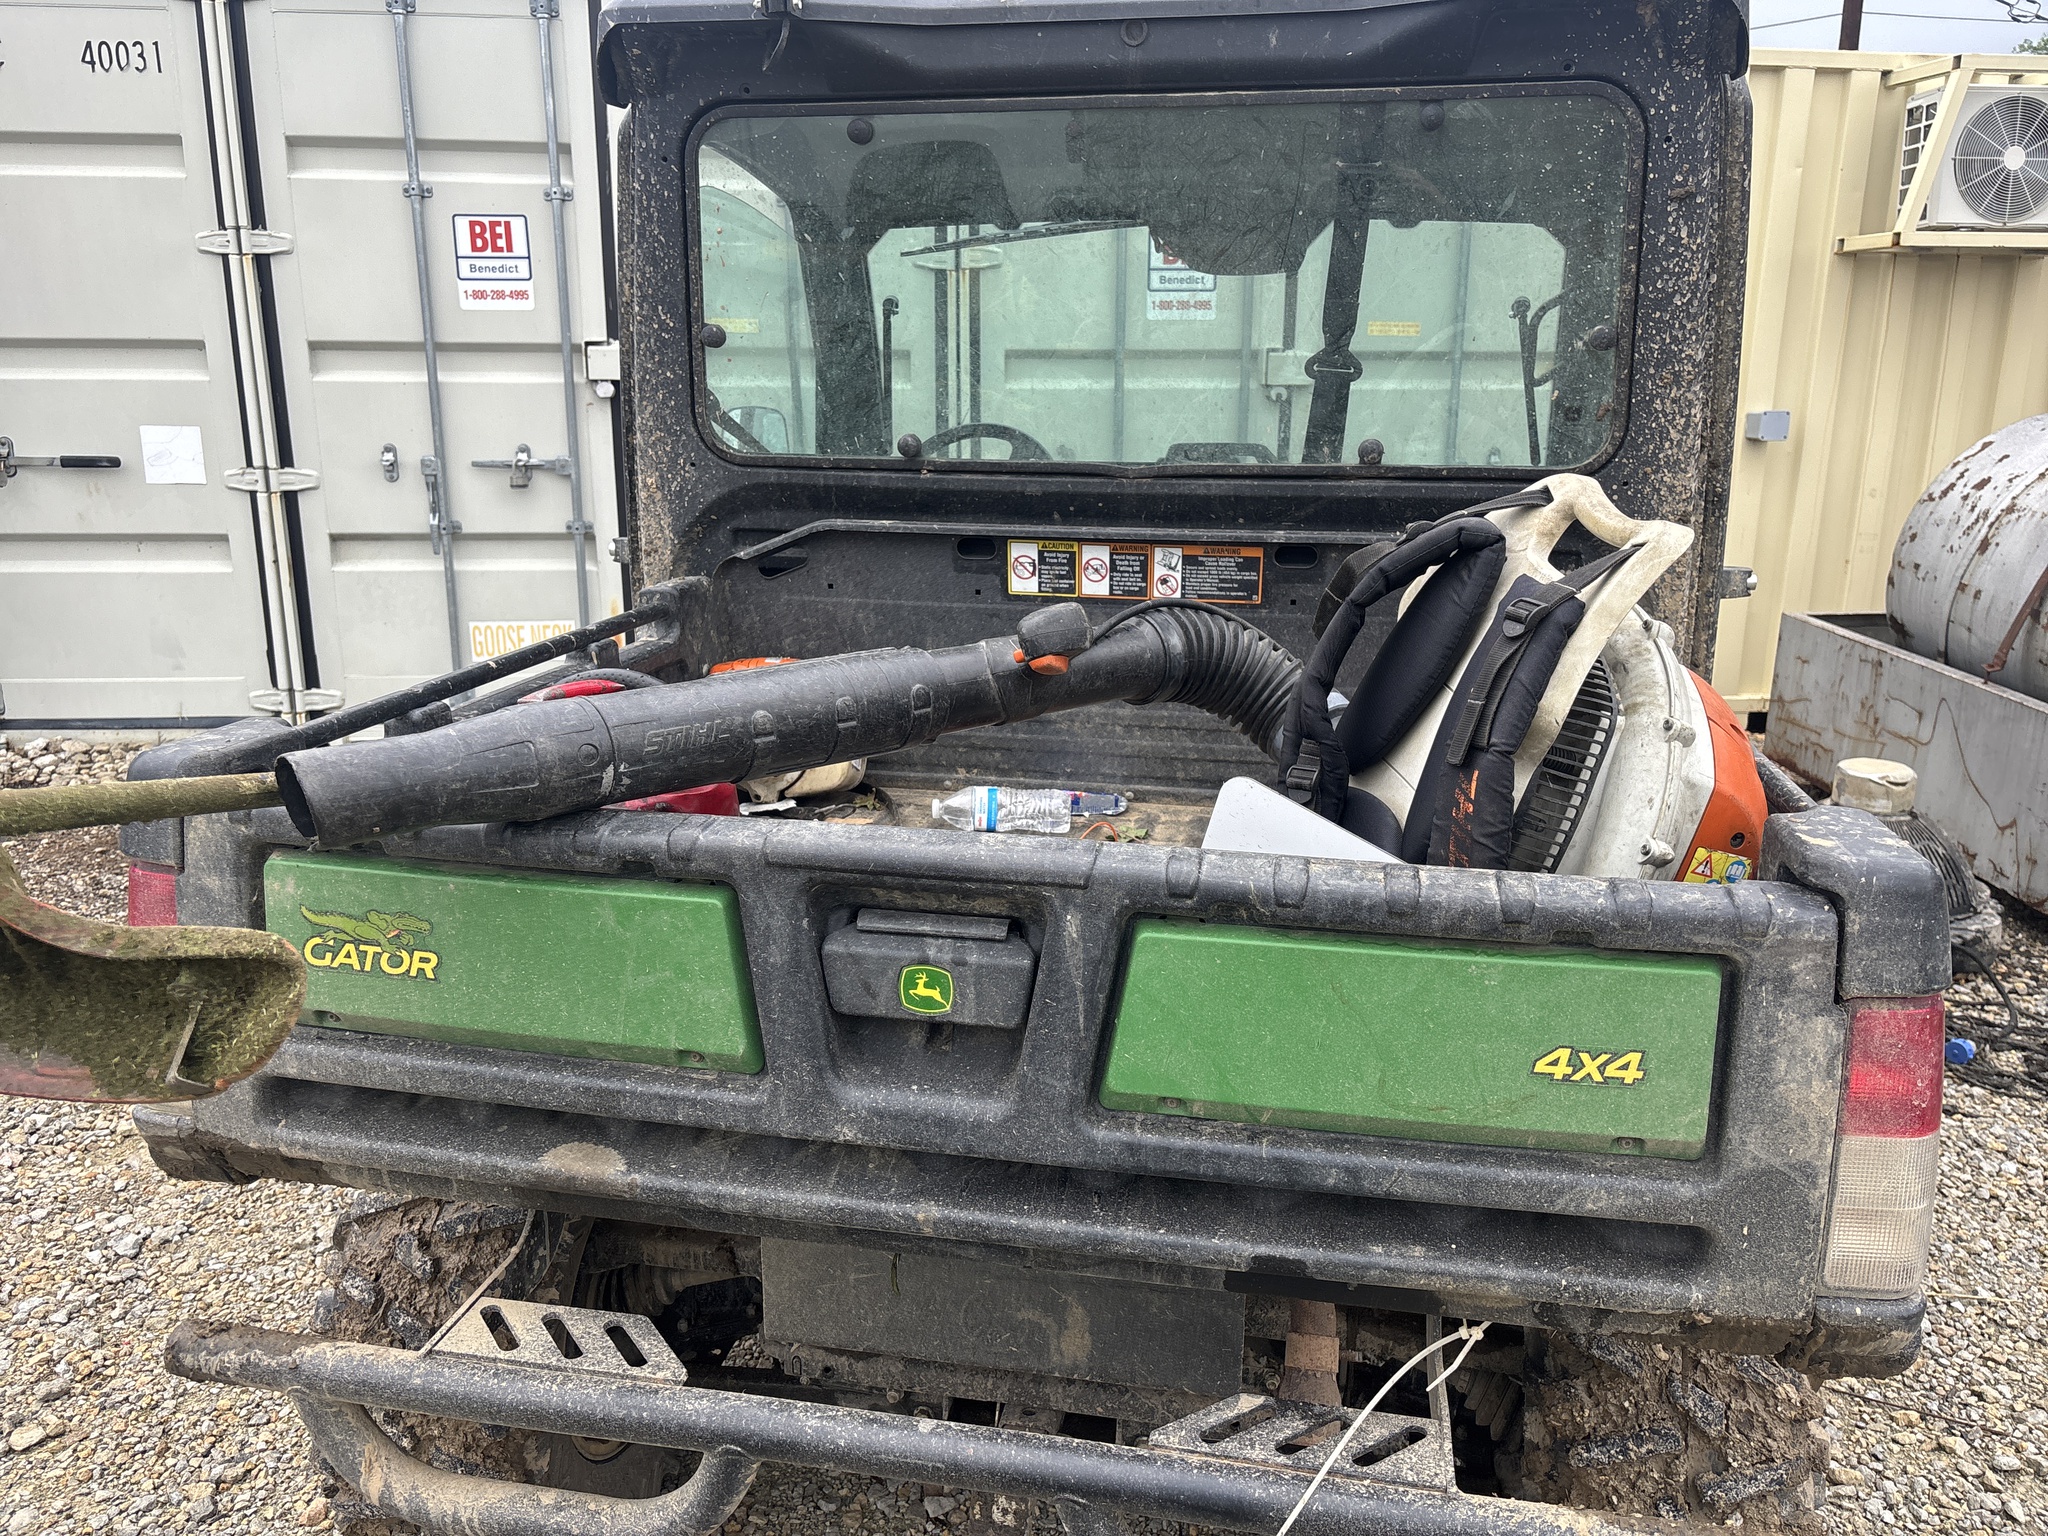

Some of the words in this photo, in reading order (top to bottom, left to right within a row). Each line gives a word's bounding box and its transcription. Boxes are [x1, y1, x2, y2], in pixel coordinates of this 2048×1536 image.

[81, 41, 162, 74] 40031
[468, 220, 514, 253] BEI
[470, 264, 518, 273] Benedict
[1159, 275, 1204, 284] Benedict
[464, 290, 529, 300] 1-800-288-4995
[472, 624, 526, 658] GOOSE
[643, 718, 730, 756] STIHL
[304, 936, 440, 980] GATOR
